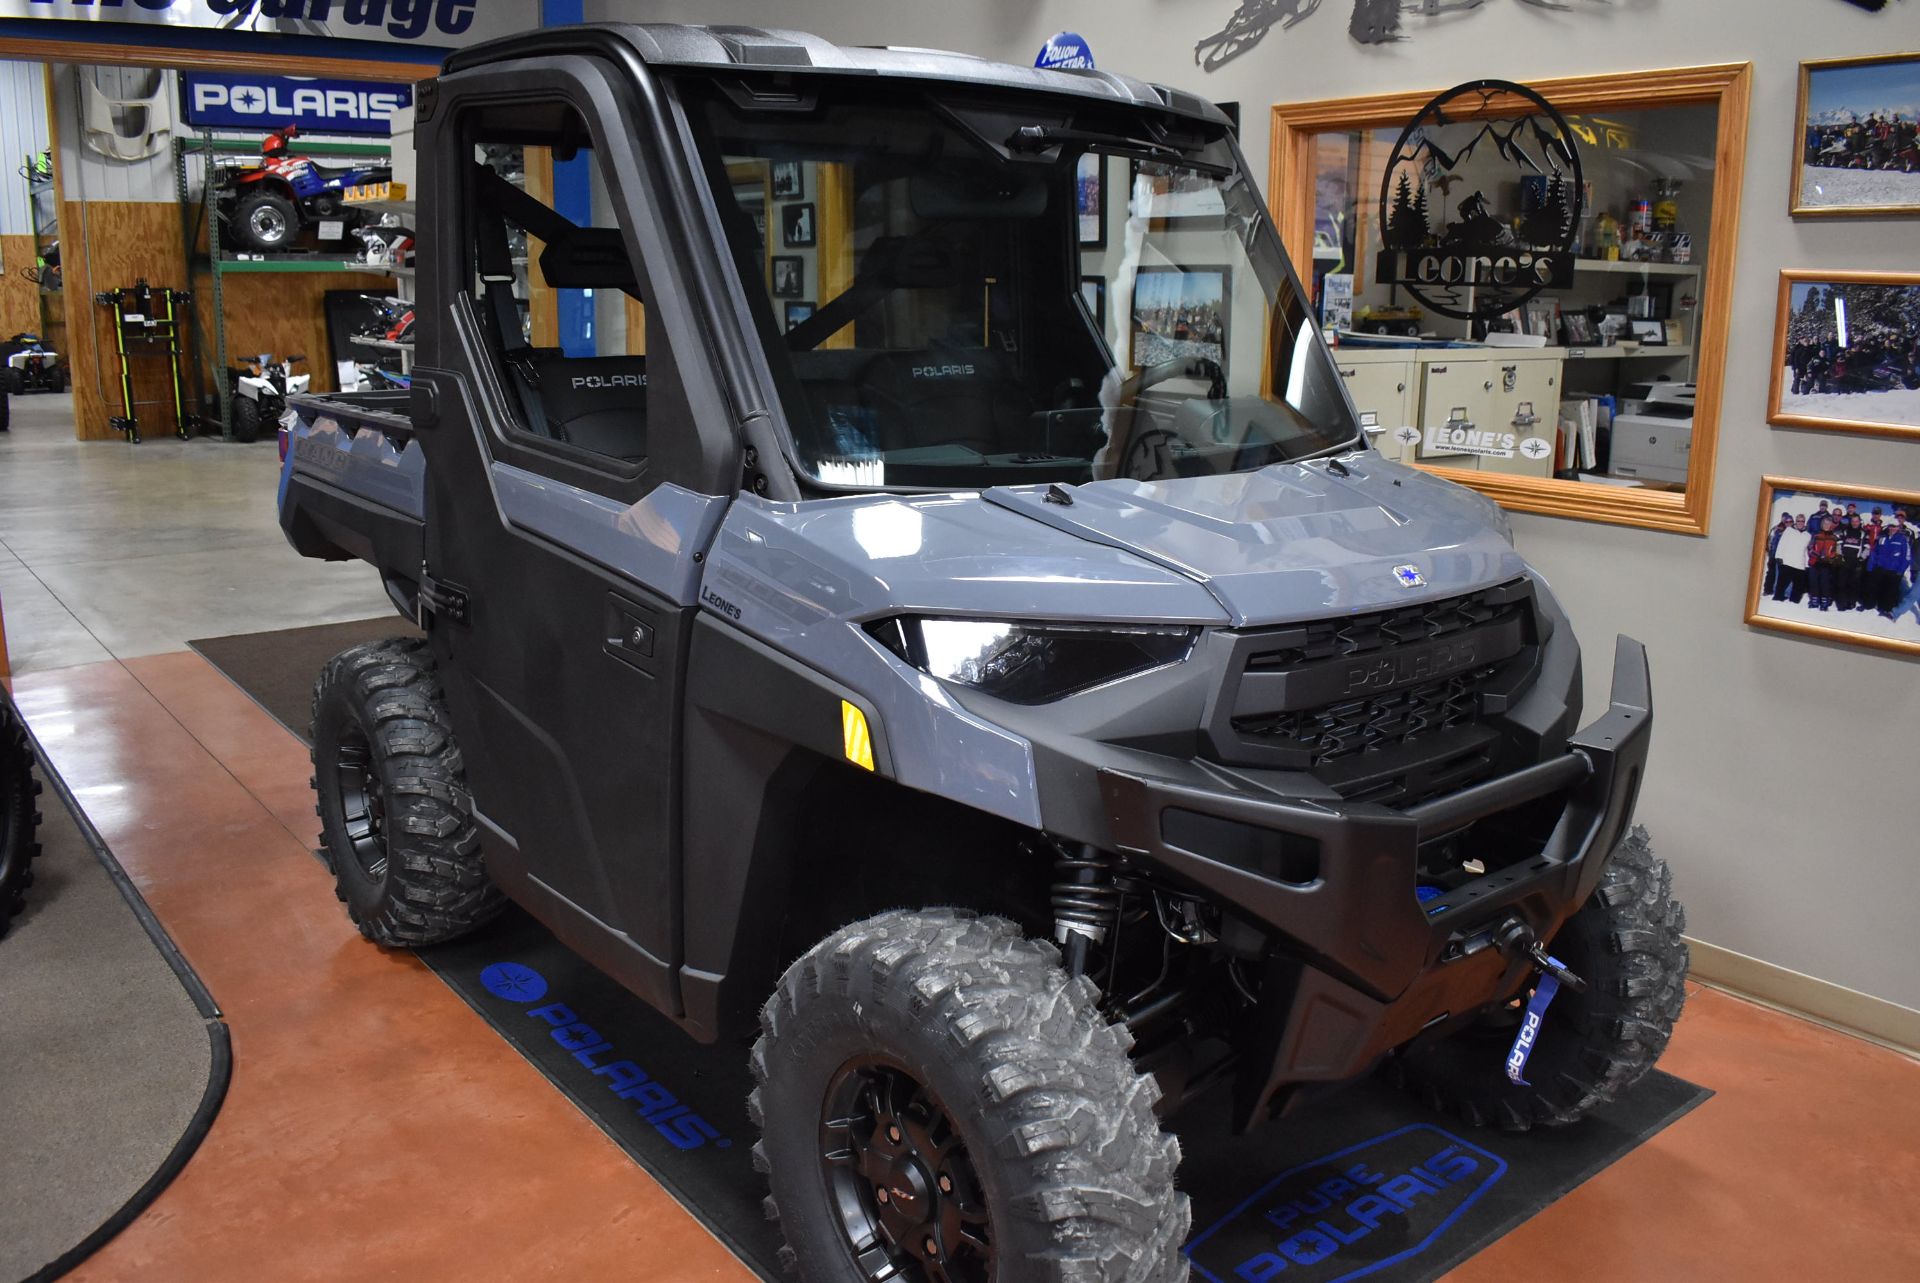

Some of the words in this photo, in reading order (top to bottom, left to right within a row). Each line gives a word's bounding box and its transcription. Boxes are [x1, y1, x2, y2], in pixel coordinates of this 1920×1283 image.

[194, 83, 399, 121] POLARIS
[1395, 252, 1553, 285] Leone's
[912, 365, 975, 378] POLARIS
[1422, 427, 1516, 452] LEONE'S
[1435, 445, 1506, 457] www.leonespolaris.com
[701, 586, 742, 620] LEONE'S
[527, 1003, 720, 1150] POLARIS
[1263, 1163, 1385, 1229] PURE
[1234, 1146, 1479, 1283] POLARIS
